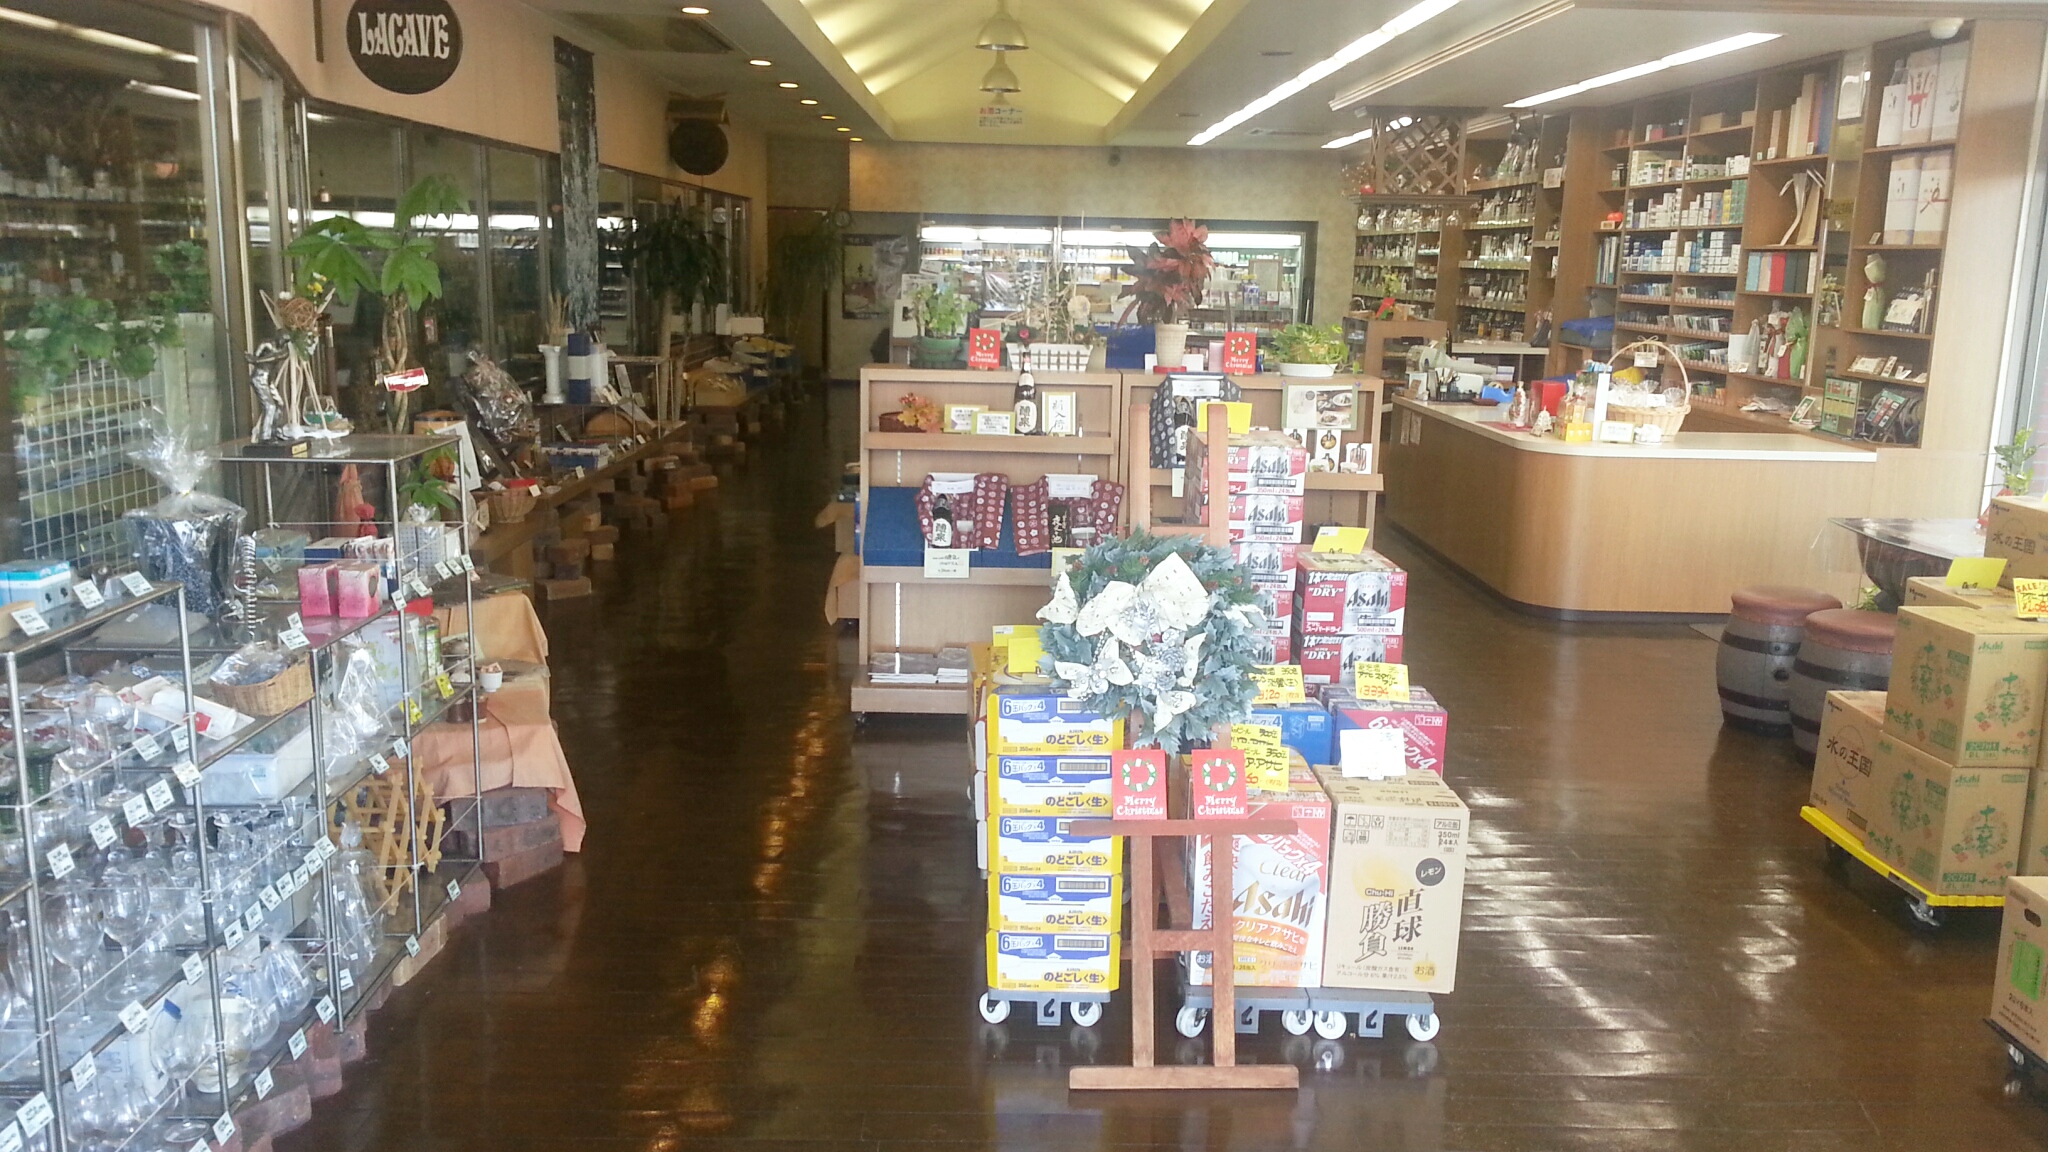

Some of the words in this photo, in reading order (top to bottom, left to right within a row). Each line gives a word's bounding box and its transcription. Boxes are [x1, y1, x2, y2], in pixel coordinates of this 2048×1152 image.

[1250, 456, 1288, 474] Asahi
[1248, 505, 1286, 522] Asahi
[1992, 530, 2036, 555] 水の王国
[1346, 588, 1389, 608] Asahi
[1826, 735, 1873, 778] 水の王国
[1124, 794, 1157, 807] Merry
[1204, 794, 1238, 807] Merry
[1116, 805, 1163, 816] Christmas
[1197, 805, 1244, 816] Christmas
[1260, 860, 1308, 883] Clear
[1420, 866, 1442, 878] レモン
[1233, 880, 1316, 928] Asahi
[1392, 888, 1425, 943] 直球
[1355, 900, 1393, 963] 勝負
[1414, 965, 1435, 976] お酒
